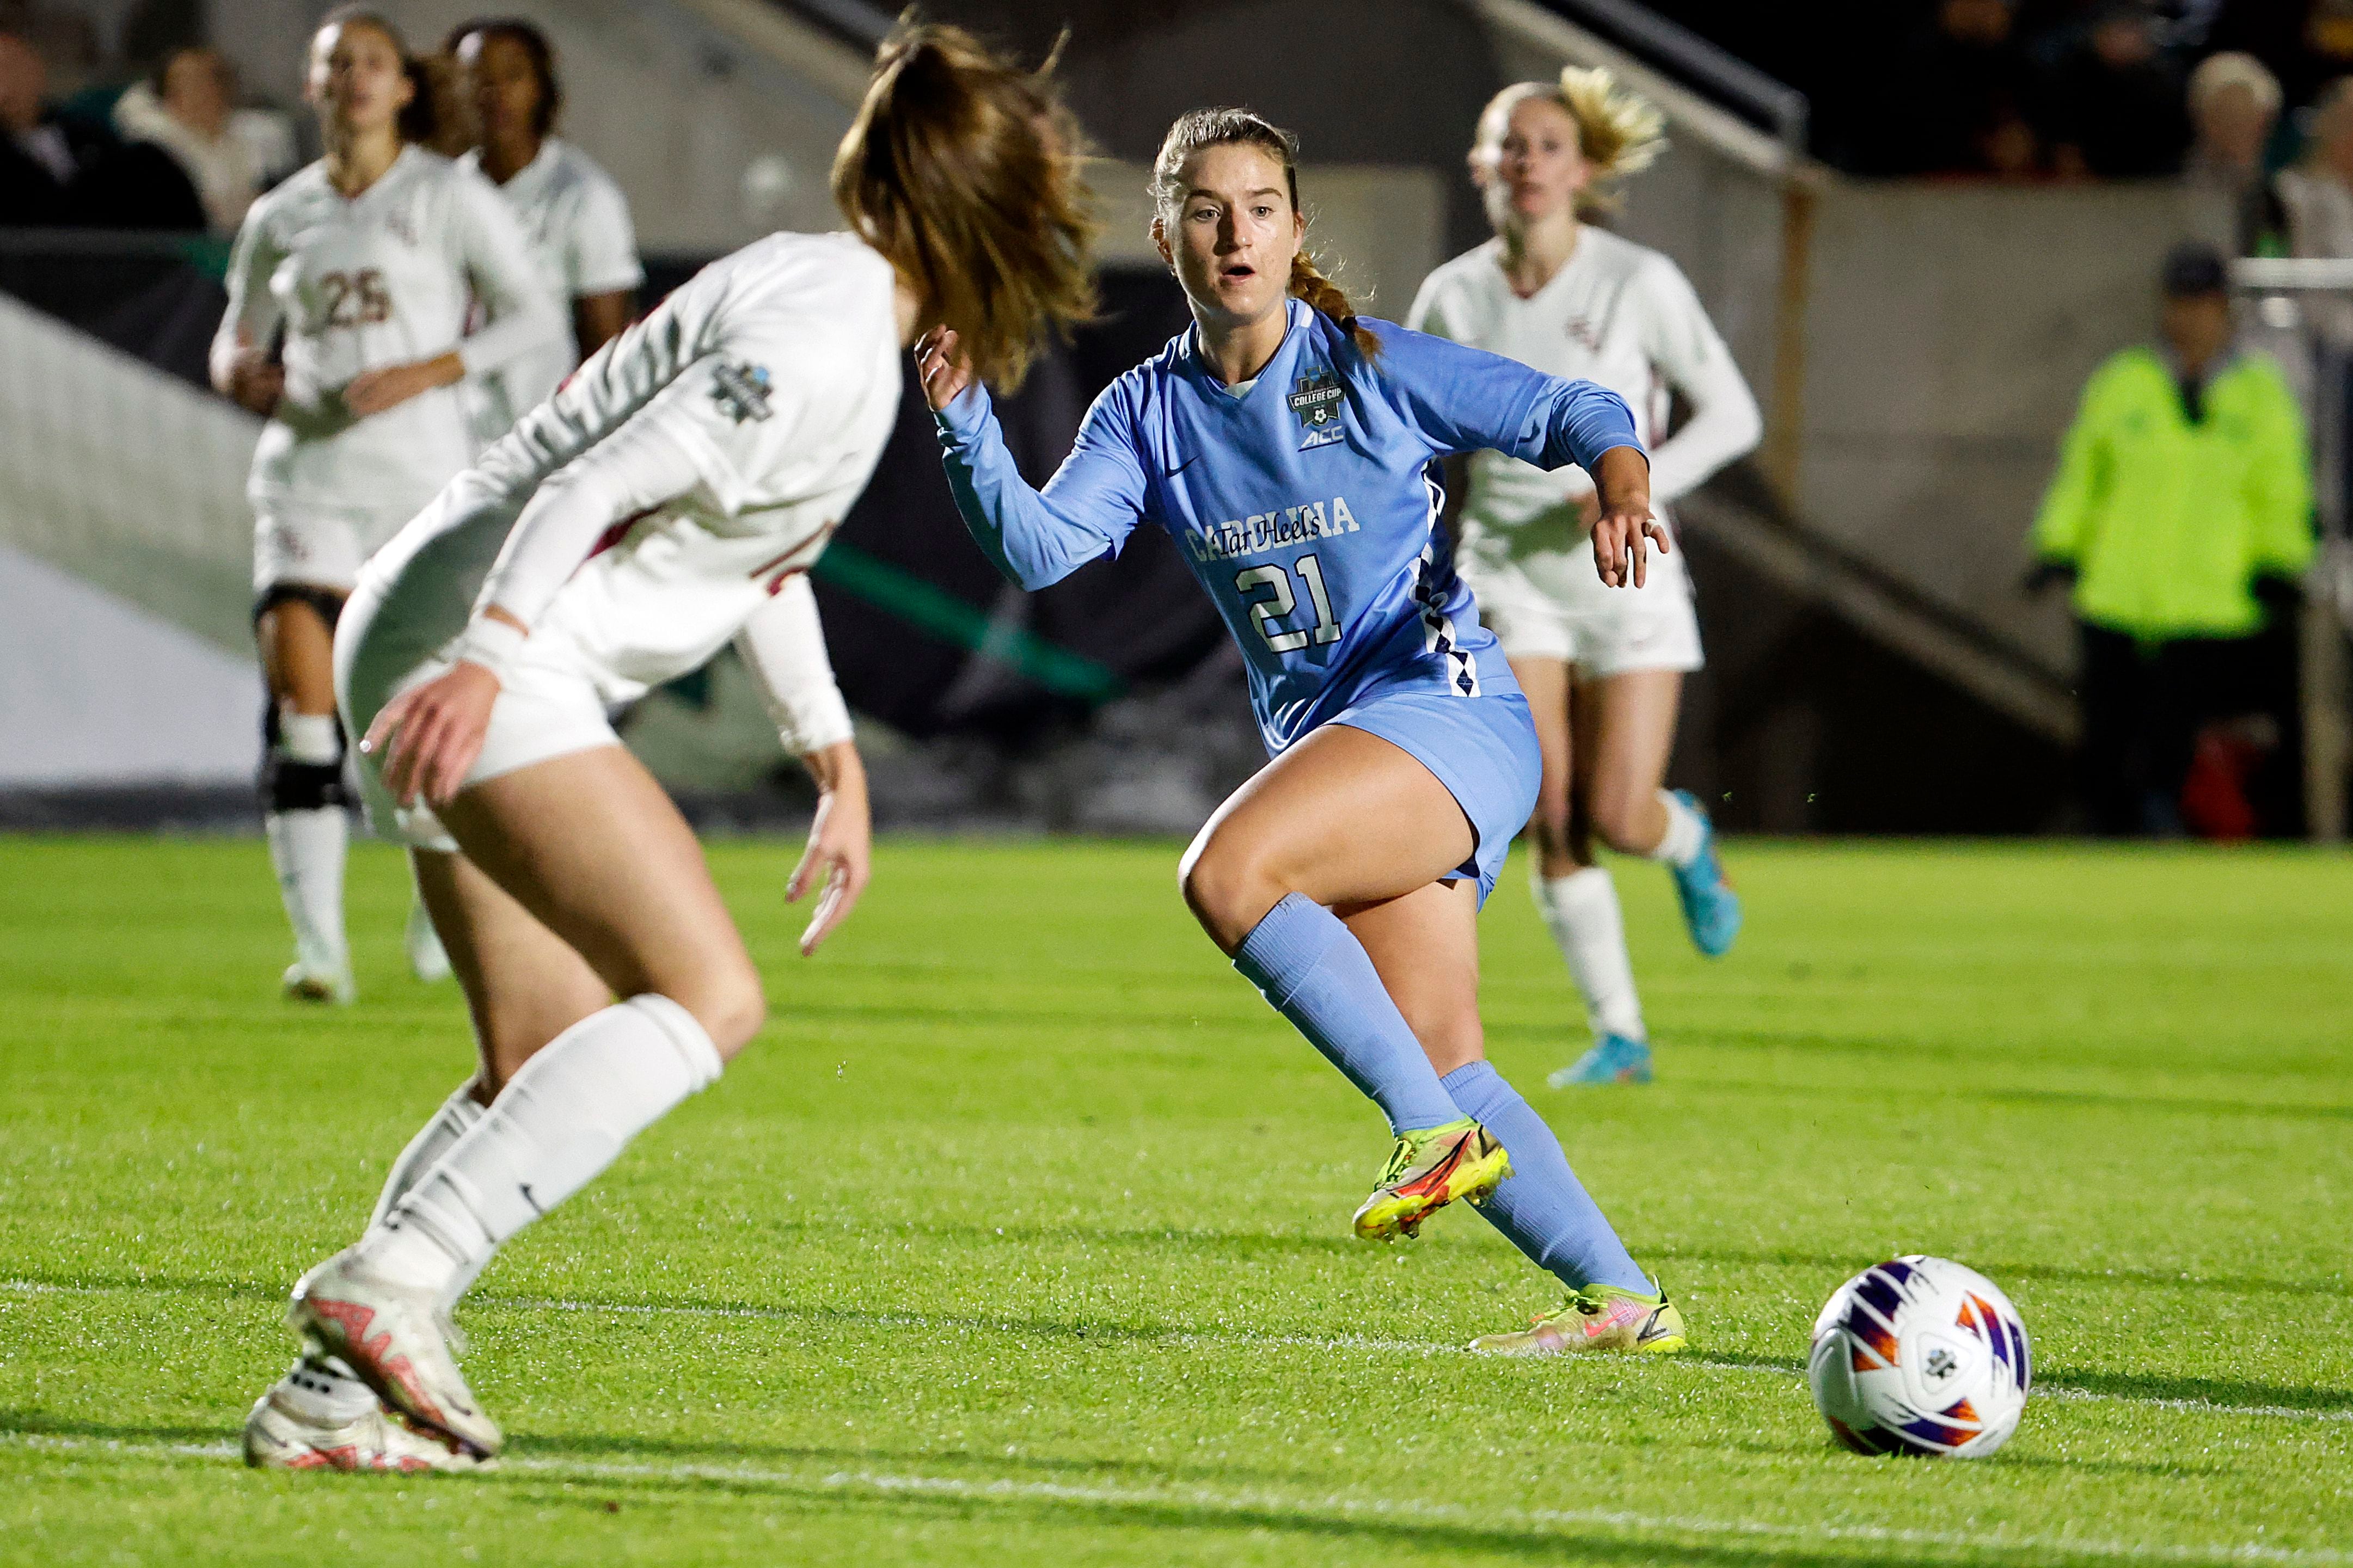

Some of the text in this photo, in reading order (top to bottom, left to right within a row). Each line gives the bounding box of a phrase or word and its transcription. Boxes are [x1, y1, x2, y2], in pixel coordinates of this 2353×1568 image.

[1294, 391, 1326, 407] COLLEGE
[1327, 388, 1341, 399] CUP
[1301, 426, 1344, 448] ACC
[1185, 496, 1360, 562] CAROLINA
[1211, 507, 1320, 556] Tar Heels
[1235, 554, 1341, 653] 21
